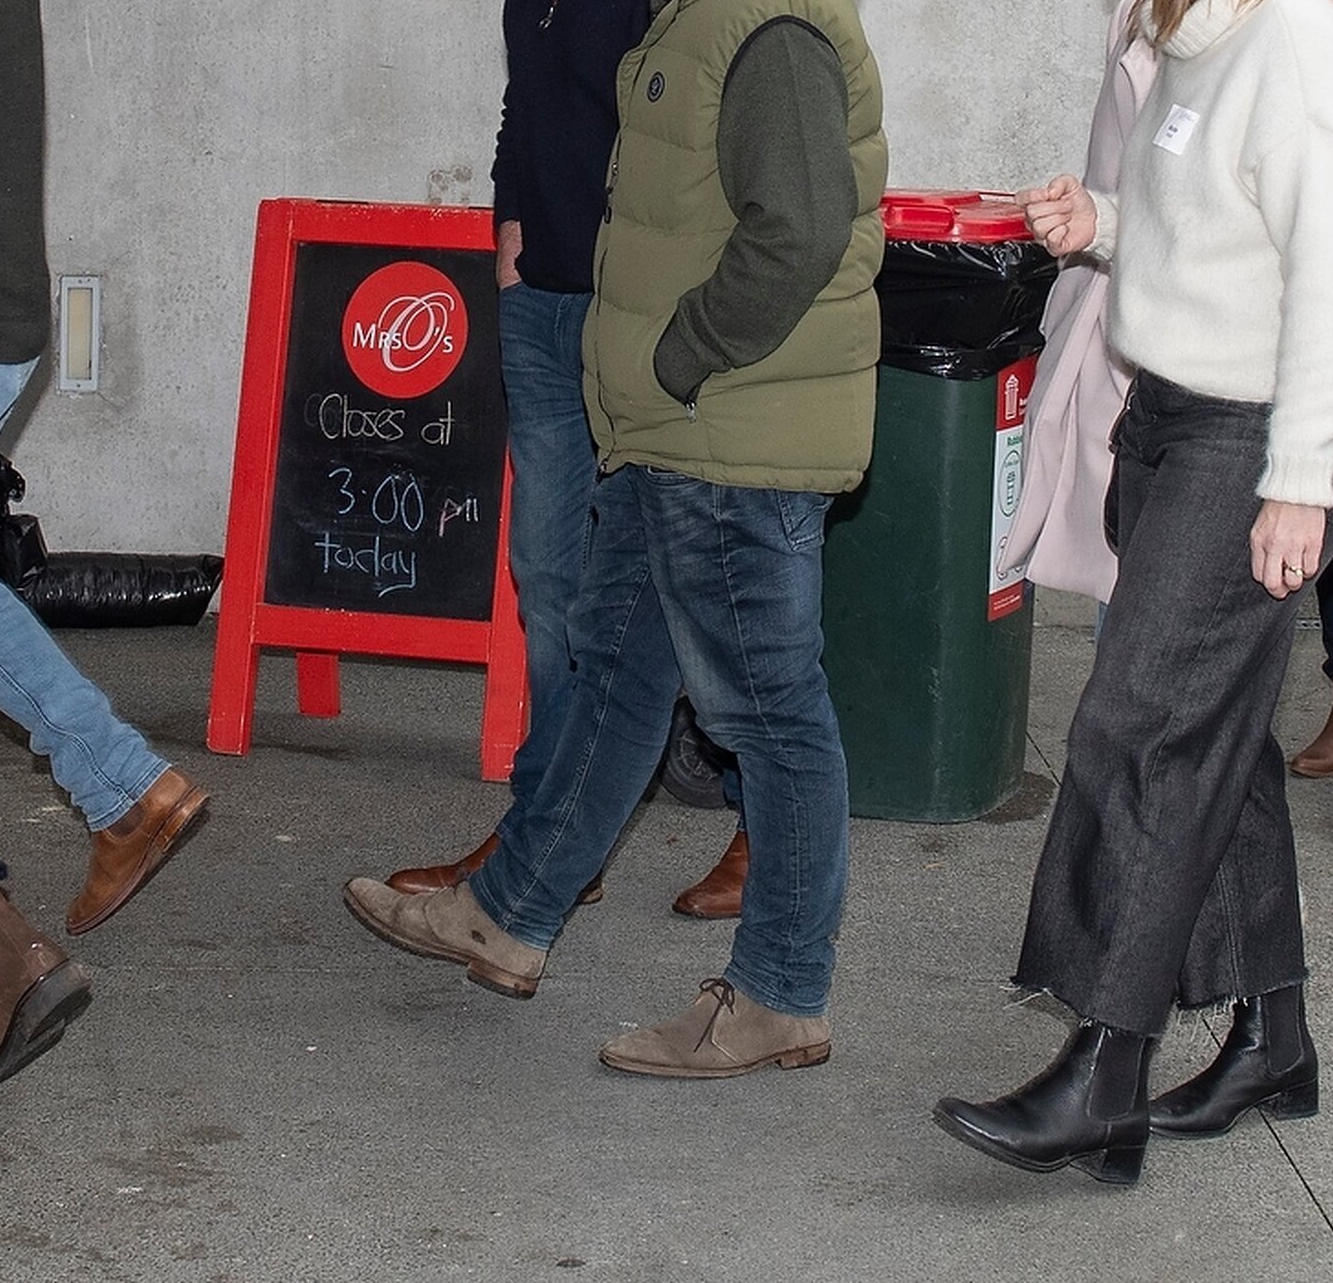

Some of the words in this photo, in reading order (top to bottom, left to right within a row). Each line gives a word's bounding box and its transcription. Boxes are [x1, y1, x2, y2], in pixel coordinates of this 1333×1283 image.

[319, 393, 406, 441] Closes
[421, 401, 456, 446] at
[314, 531, 417, 598] today
